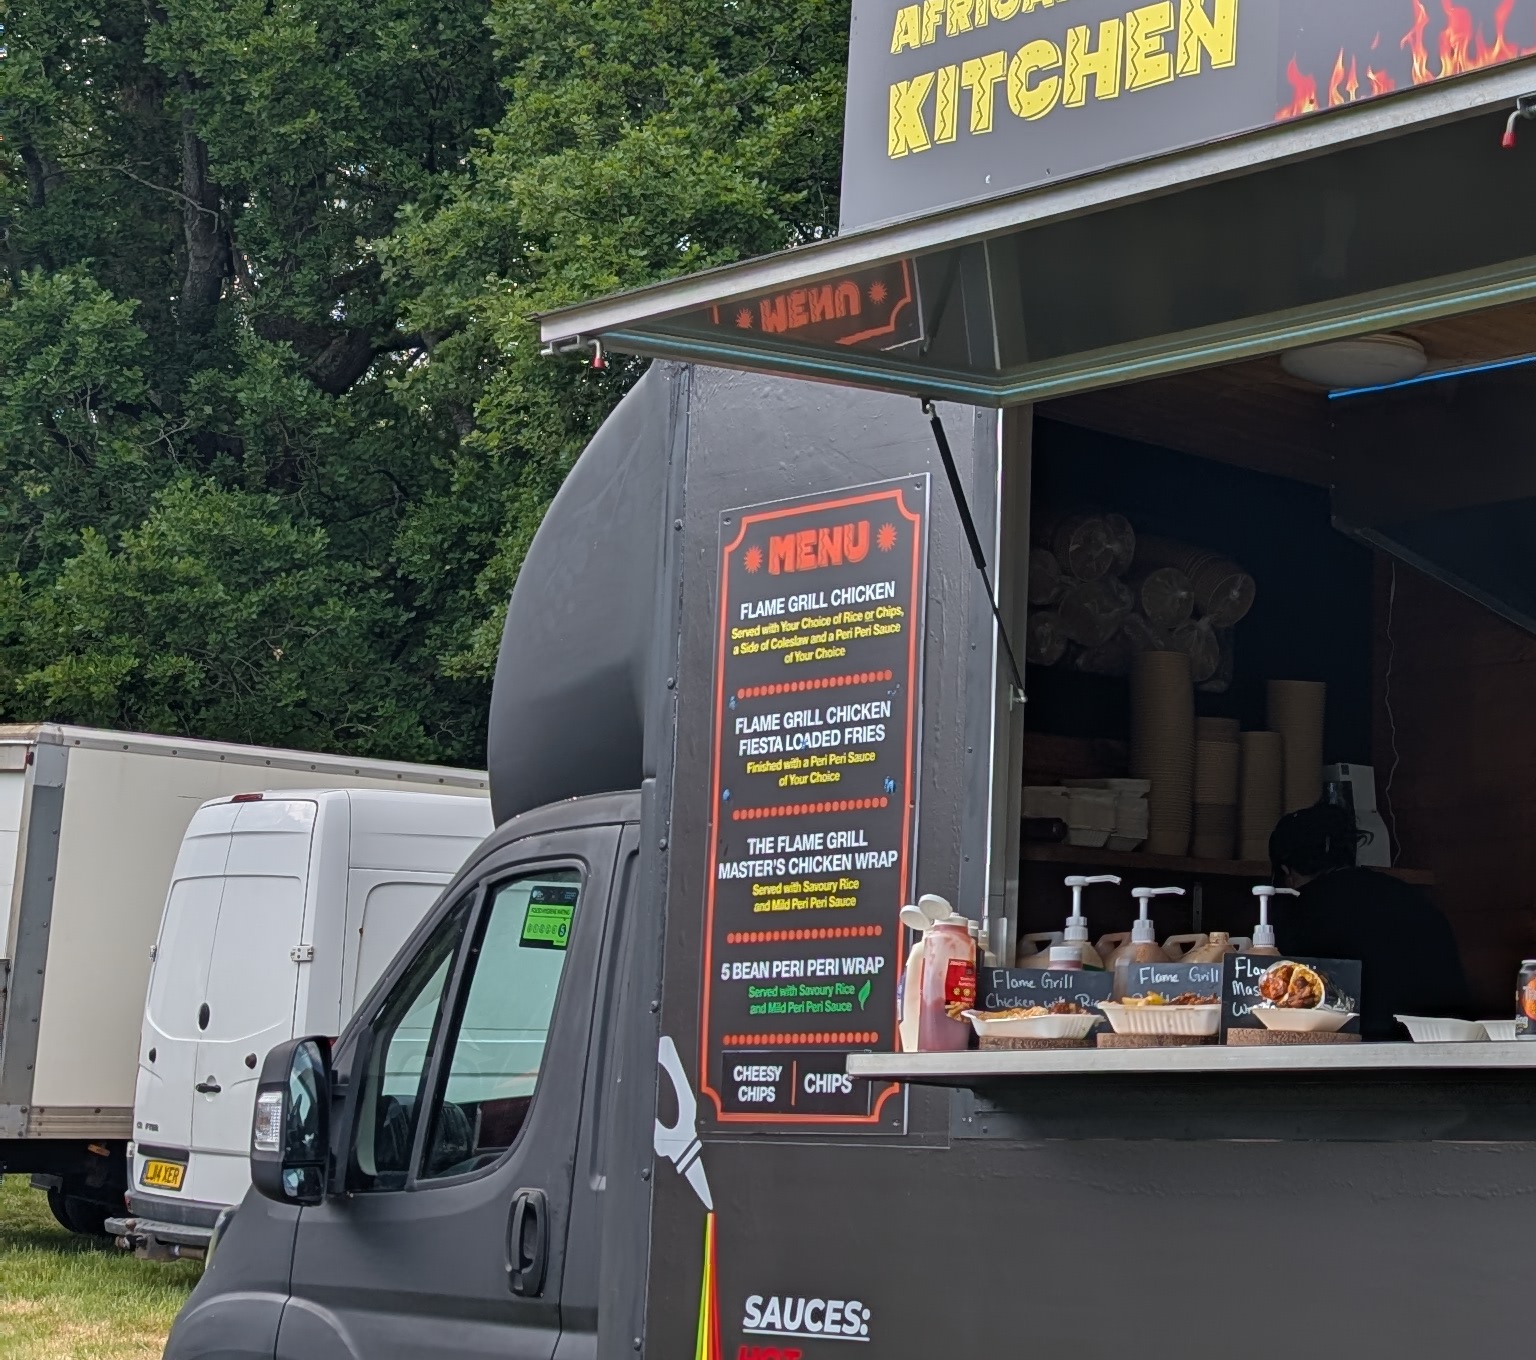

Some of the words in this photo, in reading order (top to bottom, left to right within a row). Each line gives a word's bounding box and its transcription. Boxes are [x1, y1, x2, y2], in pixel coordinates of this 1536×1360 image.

[768, 520, 870, 575] MENU
[740, 597, 786, 621] FLAME
[787, 591, 829, 613] GRILL
[830, 580, 896, 607] CHICKEN
[784, 651, 795, 664] of
[794, 648, 815, 663] Your
[815, 645, 847, 661] Choice
[735, 713, 781, 735] FLAME
[783, 708, 824, 729] GRILL
[826, 700, 891, 724] CHICKEN
[738, 735, 784, 756] FIESTA
[785, 729, 842, 752] LOADED
[844, 723, 886, 745] FRIES
[746, 836, 775, 856] THE
[777, 832, 824, 853] FLAME
[826, 829, 869, 850] GRILL
[718, 858, 786, 879] MASTER'S
[788, 853, 852, 875] CHICKEN
[854, 850, 898, 870] WRAP
[720, 963, 730, 981] 5
[732, 961, 770, 980] BEAN
[772, 959, 804, 978] PERI
[807, 958, 840, 977] PERI
[841, 956, 885, 975] WRAP
[991, 969, 1037, 990] Flame
[1041, 971, 1074, 990] Grill
[1138, 966, 1180, 985] Flame
[1188, 965, 1219, 983] Grill
[985, 992, 1036, 1010] Chicken
[733, 1065, 783, 1082] CHEESY
[803, 1072, 853, 1094] CHIPS
[737, 1085, 776, 1103] CHIPS
[742, 1294, 871, 1337] SAUCES:
